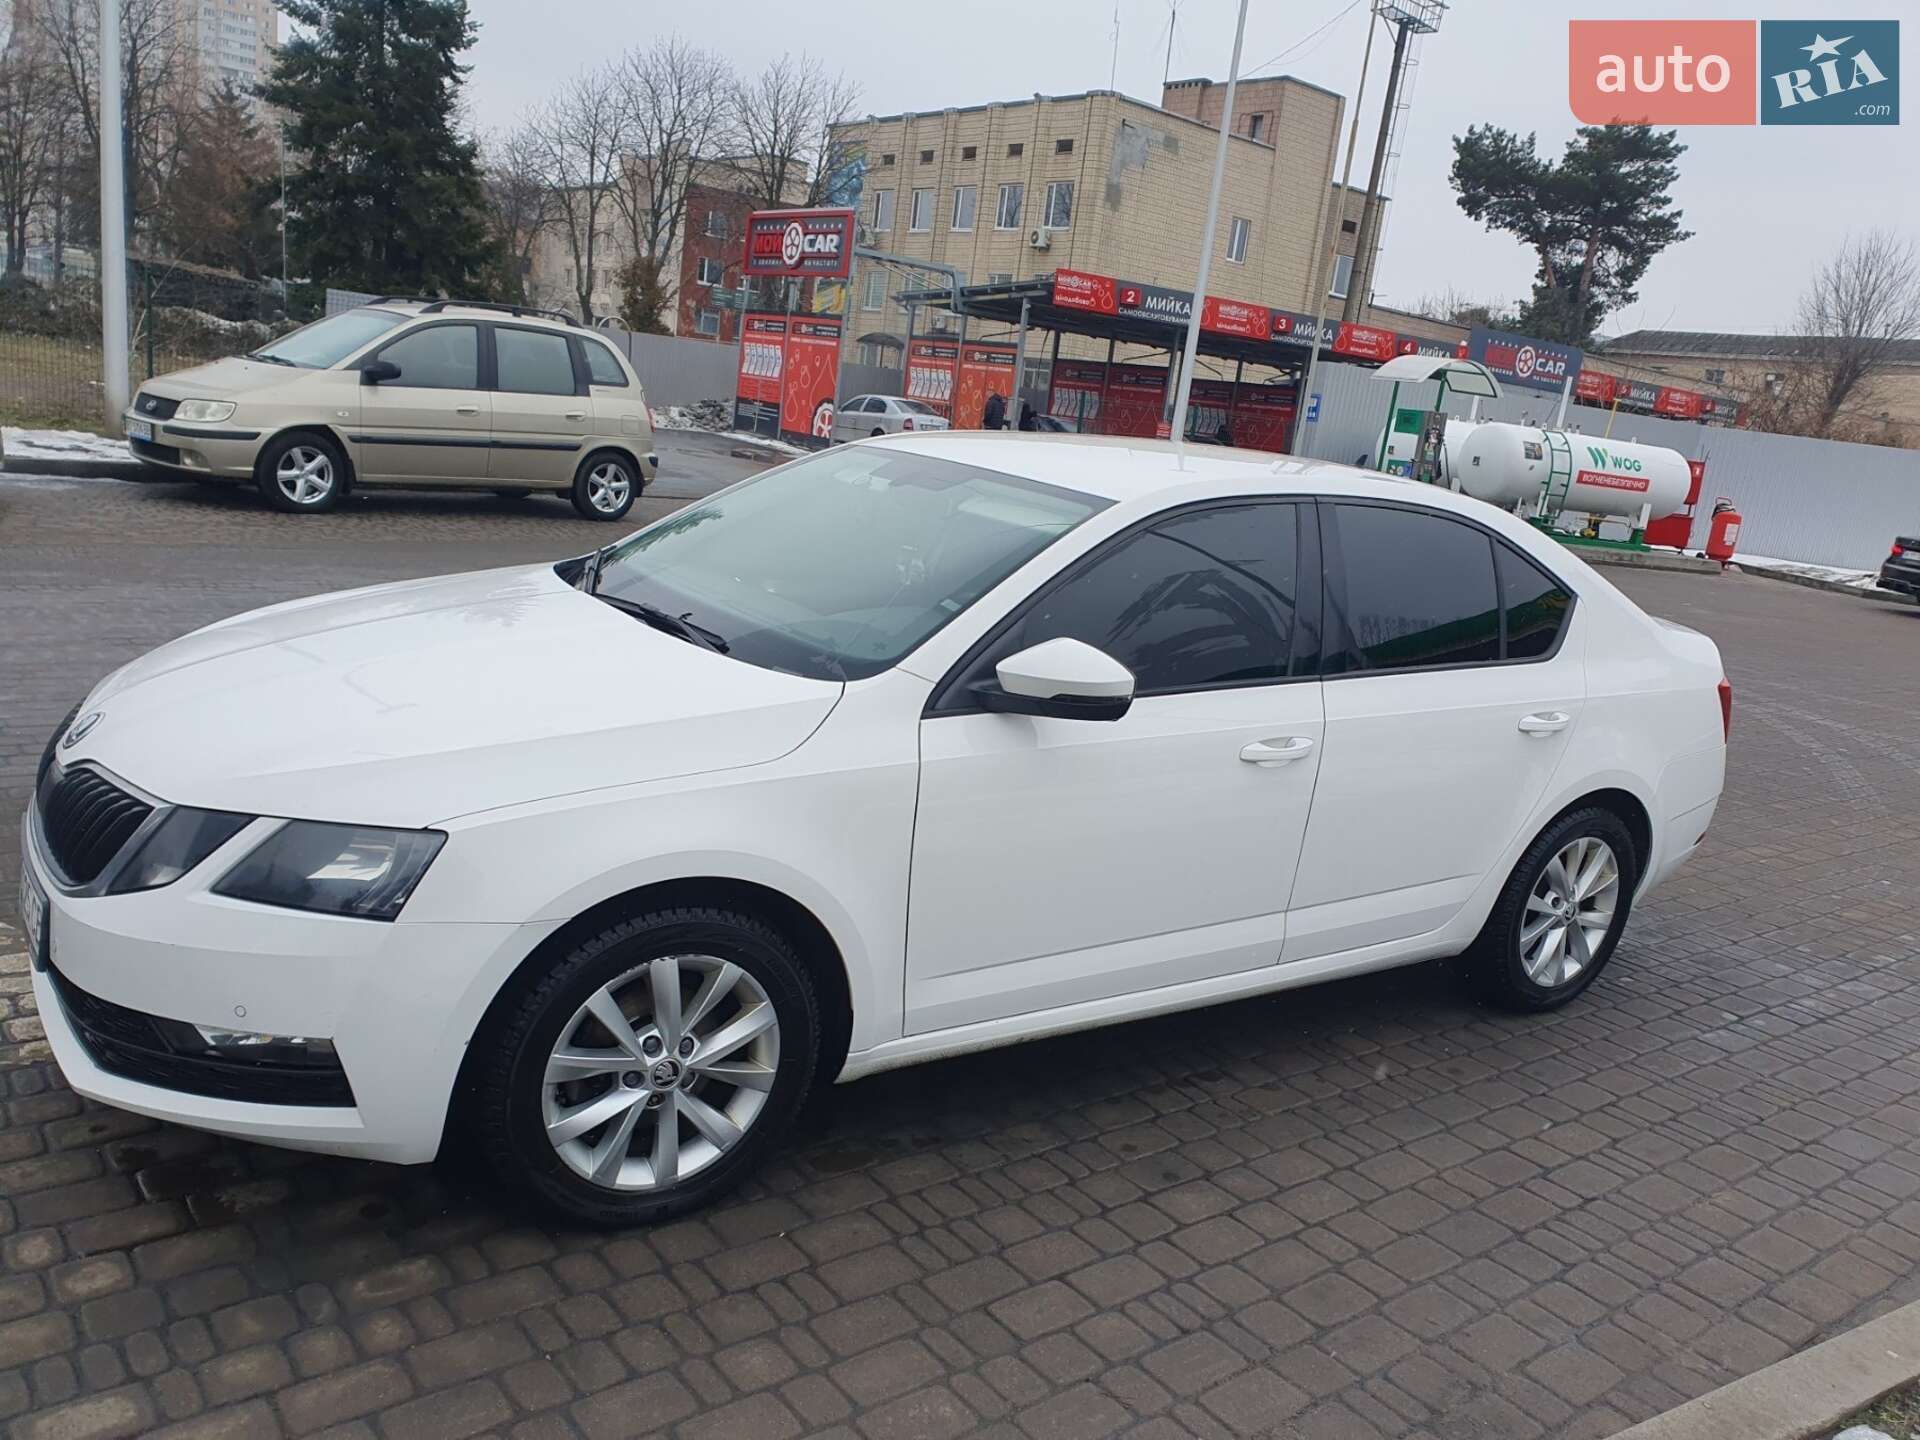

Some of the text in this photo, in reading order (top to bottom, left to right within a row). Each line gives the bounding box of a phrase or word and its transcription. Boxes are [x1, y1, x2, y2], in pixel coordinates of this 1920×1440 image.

[803, 233, 841, 253] CAR
[1127, 290, 1135, 302] 2
[1145, 295, 1191, 316] МИЙКА
[1279, 318, 1286, 329] 3
[1404, 342, 1412, 352] 4
[1535, 358, 1566, 376] CAR
[1611, 455, 1642, 472] WOG
